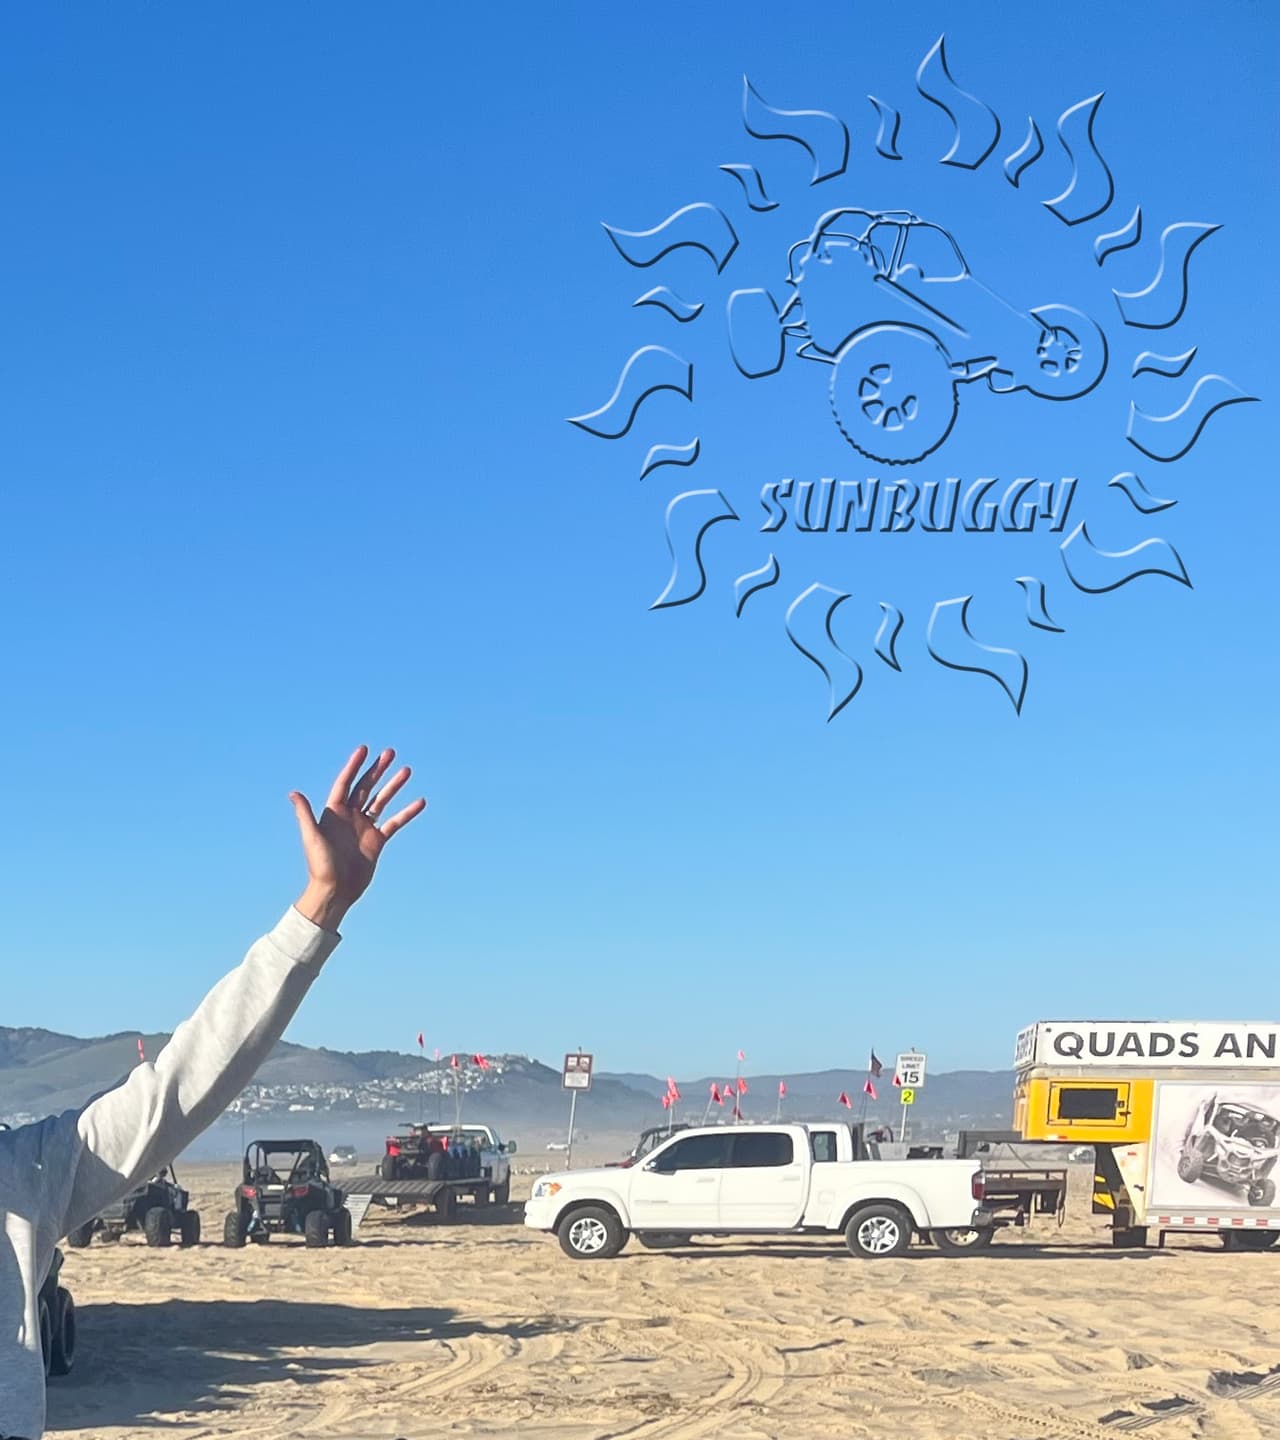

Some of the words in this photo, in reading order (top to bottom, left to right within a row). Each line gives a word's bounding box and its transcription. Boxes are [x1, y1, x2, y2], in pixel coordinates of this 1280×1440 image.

[1053, 1031, 1200, 1059] QUADS
[1213, 1033, 1277, 1058] AN
[902, 1071, 919, 1084] 15
[903, 1090, 912, 1103] 2
